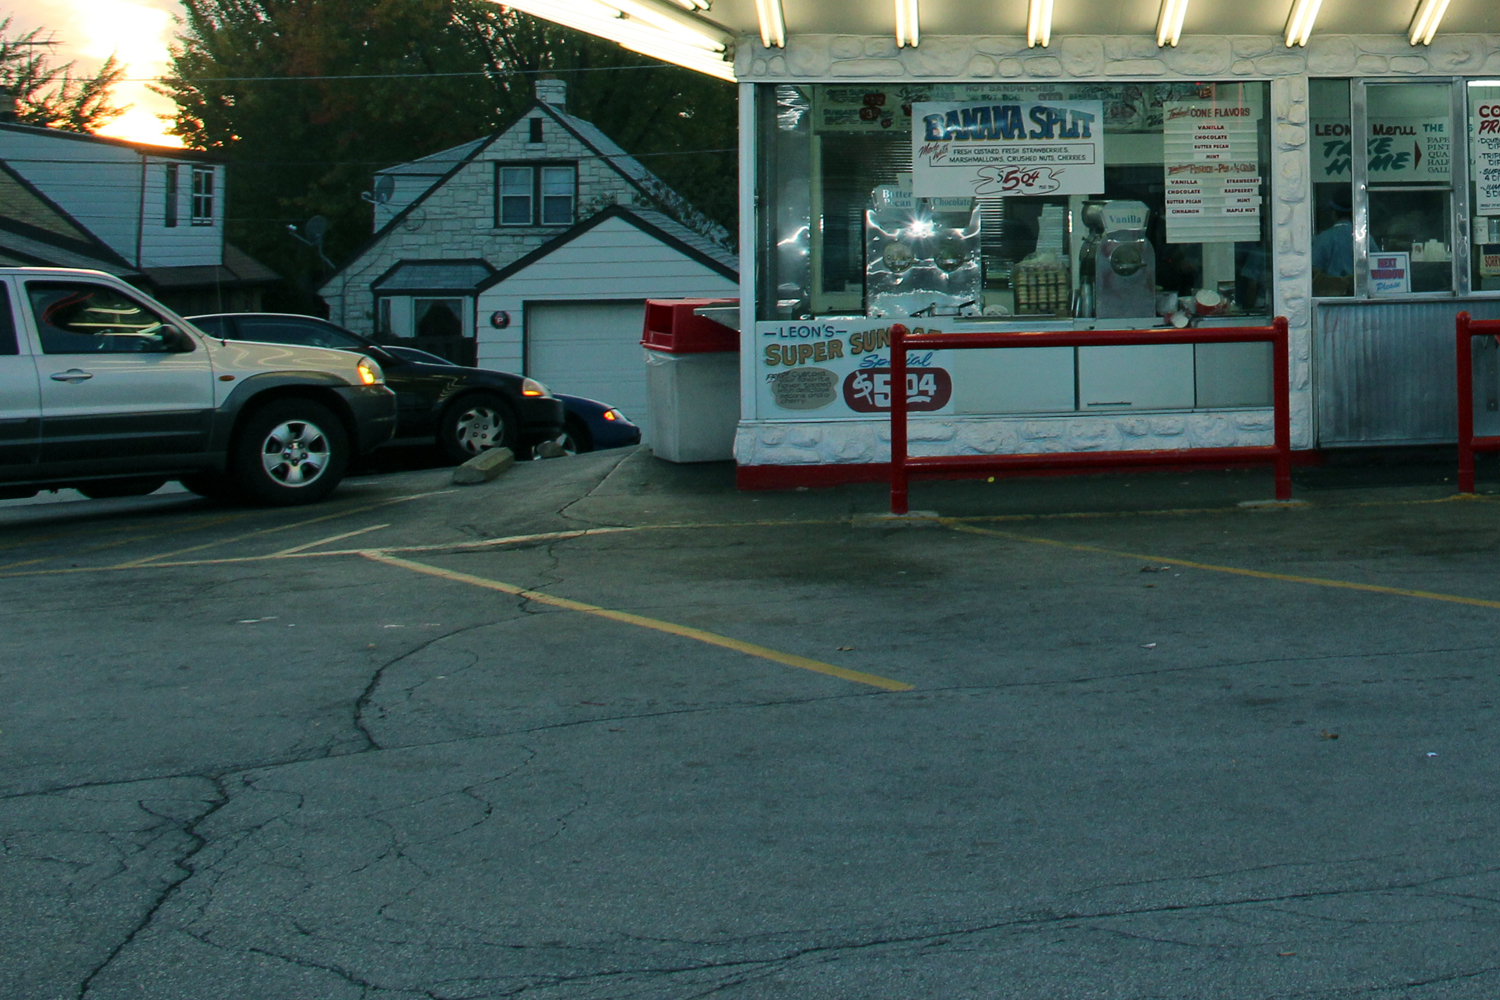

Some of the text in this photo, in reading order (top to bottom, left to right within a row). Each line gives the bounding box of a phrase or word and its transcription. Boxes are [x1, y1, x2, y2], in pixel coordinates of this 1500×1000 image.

[1190, 107, 1251, 118] CONE FLAVORS
[921, 104, 1028, 142] BANANA
[1029, 104, 1096, 141] SPLIT
[1422, 123, 1444, 132] THE
[1372, 123, 1417, 136] Menu
[953, 148, 974, 156] FRESH
[1001, 147, 1021, 155] FRESH
[1324, 151, 1412, 176] HME
[1109, 214, 1142, 224] Vanilla
[1377, 257, 1398, 269] NEXT
[1484, 255, 1500, 268] SORRY
[1371, 269, 1405, 280] WINDOW
[1375, 281, 1401, 292] Please
[780, 324, 836, 338] LEON'S
[765, 338, 845, 366] SUPER
[859, 351, 934, 369] Spial
